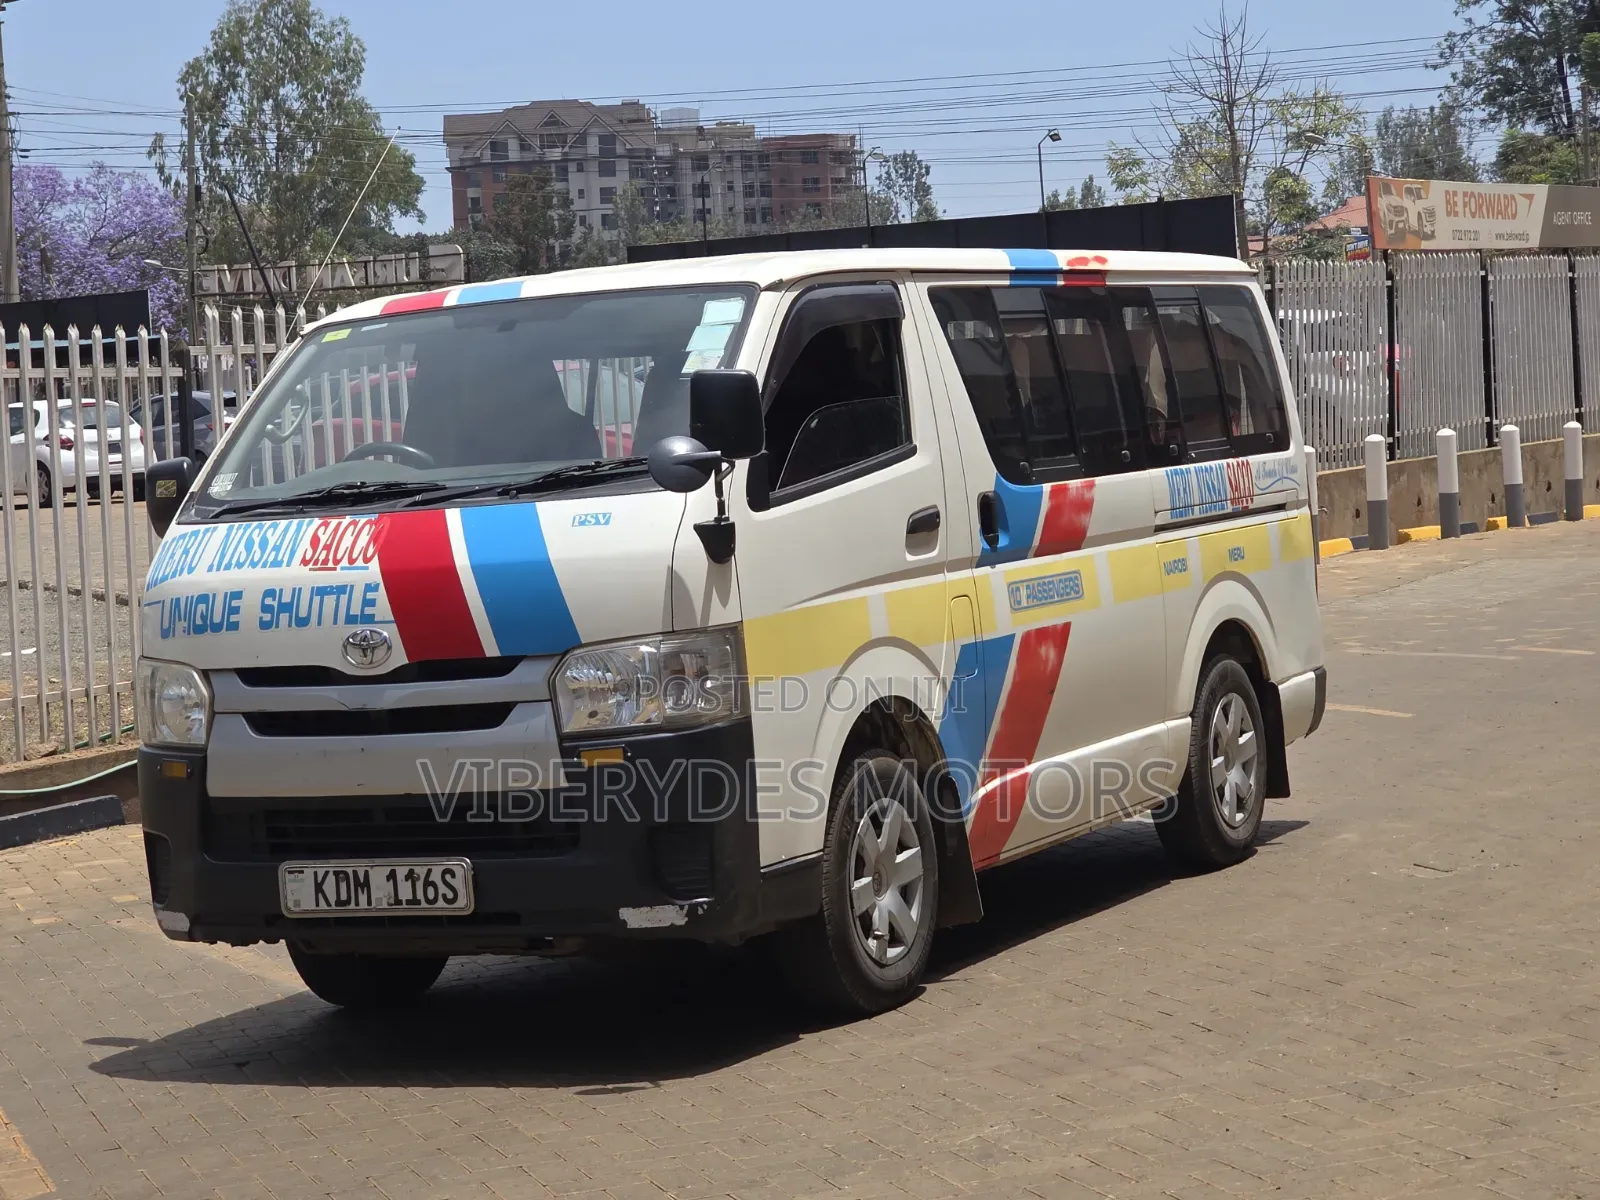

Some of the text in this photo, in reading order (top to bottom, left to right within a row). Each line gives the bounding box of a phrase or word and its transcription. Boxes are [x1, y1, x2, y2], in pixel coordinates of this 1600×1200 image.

[1444, 189, 1518, 221] BE FORWARD
[1552, 211, 1592, 226] AGENT OFFICE
[1165, 457, 1255, 520] MERU NISSAN SACCO
[573, 512, 611, 527] PSV
[145, 517, 391, 592] MERU NISSAN SACCO
[1163, 557, 1188, 576] NAIROBI
[1228, 546, 1245, 562] MERU
[1025, 576, 1081, 605] PASSENGERS
[160, 582, 381, 640] UNIQUE SHUTTLE
[313, 867, 459, 908] KDM 116S
